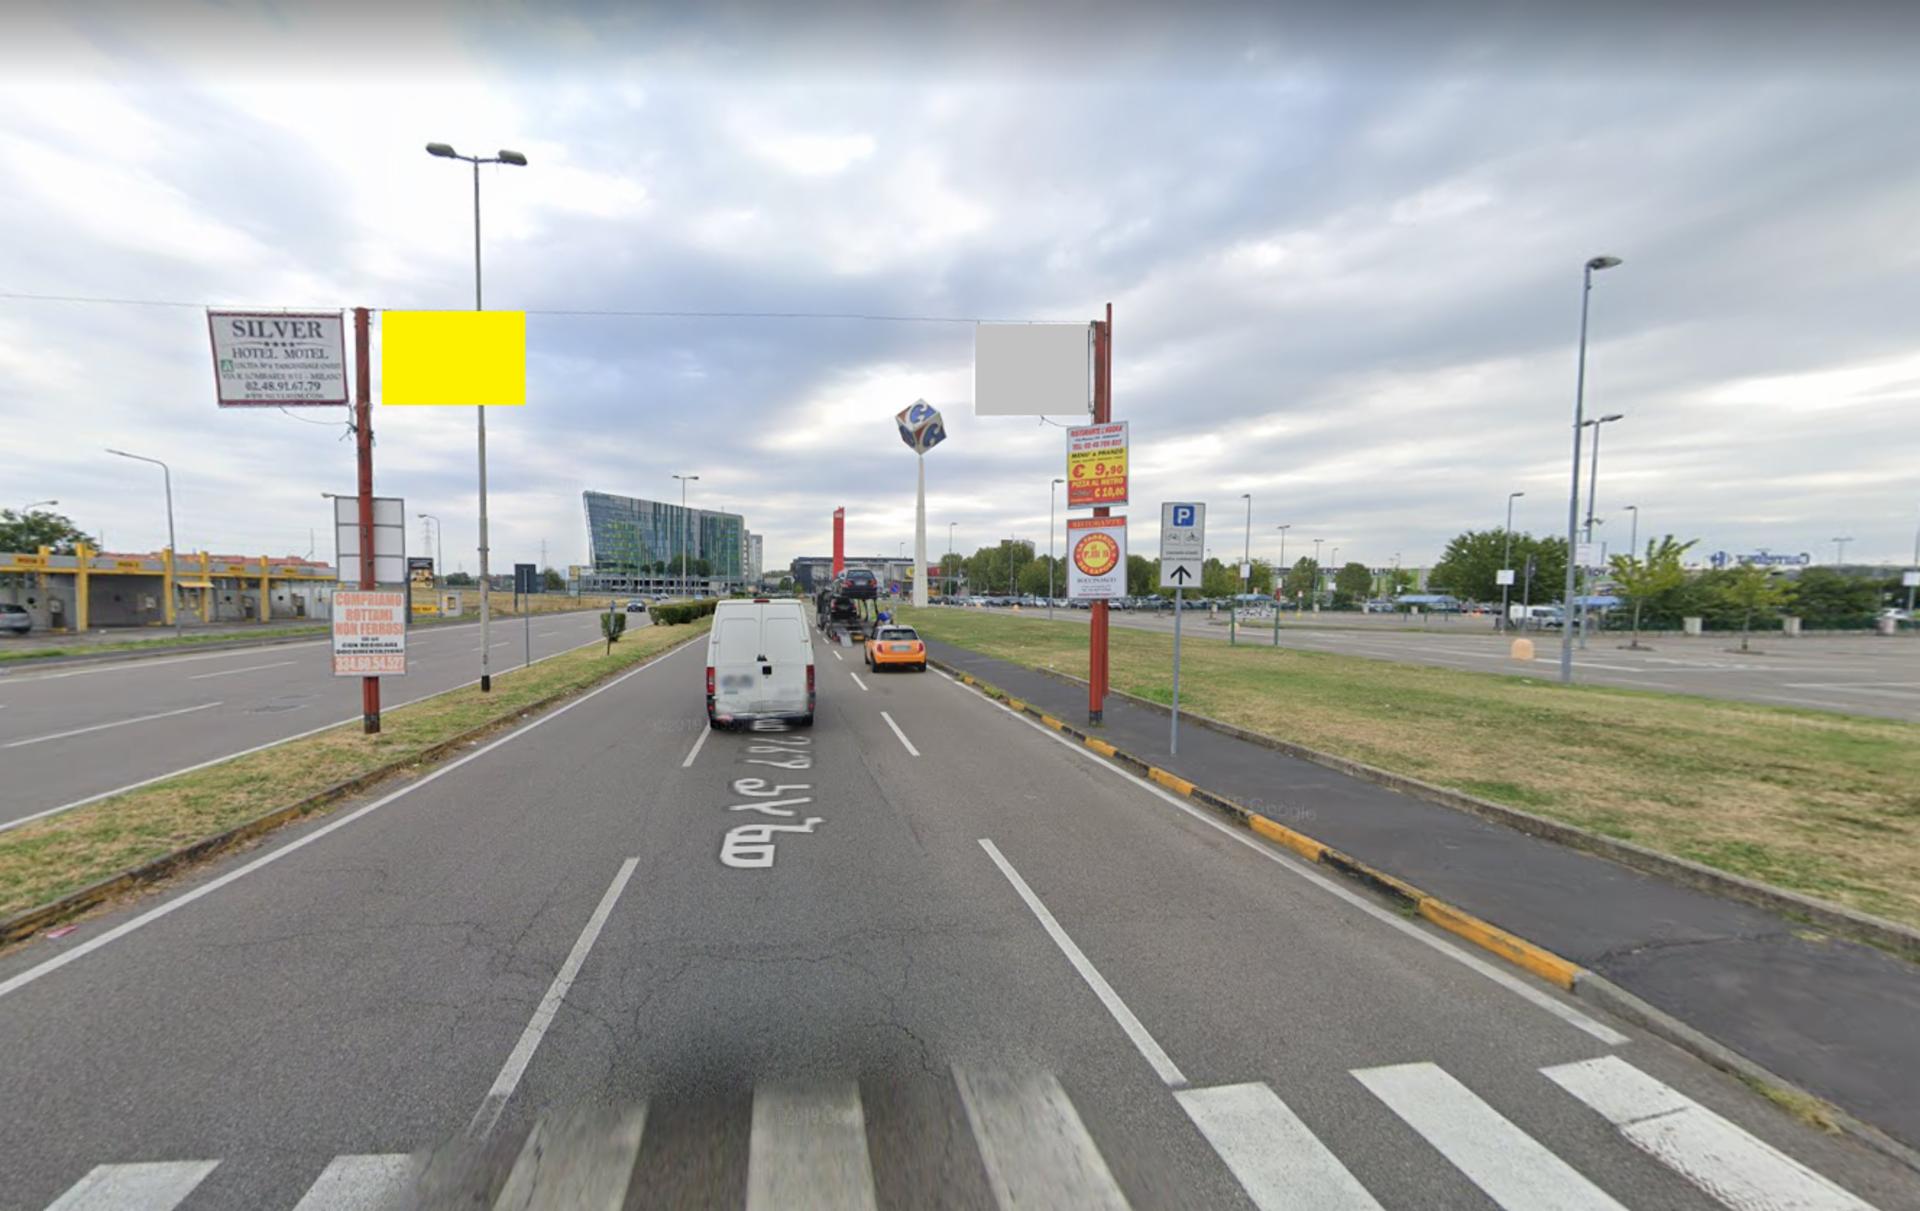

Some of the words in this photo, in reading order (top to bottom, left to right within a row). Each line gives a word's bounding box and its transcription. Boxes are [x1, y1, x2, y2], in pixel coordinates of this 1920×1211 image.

[231, 320, 324, 339] SILVER
[232, 348, 277, 359] HOTEL
[284, 348, 329, 359] MOTEL
[1177, 508, 1191, 525] P
